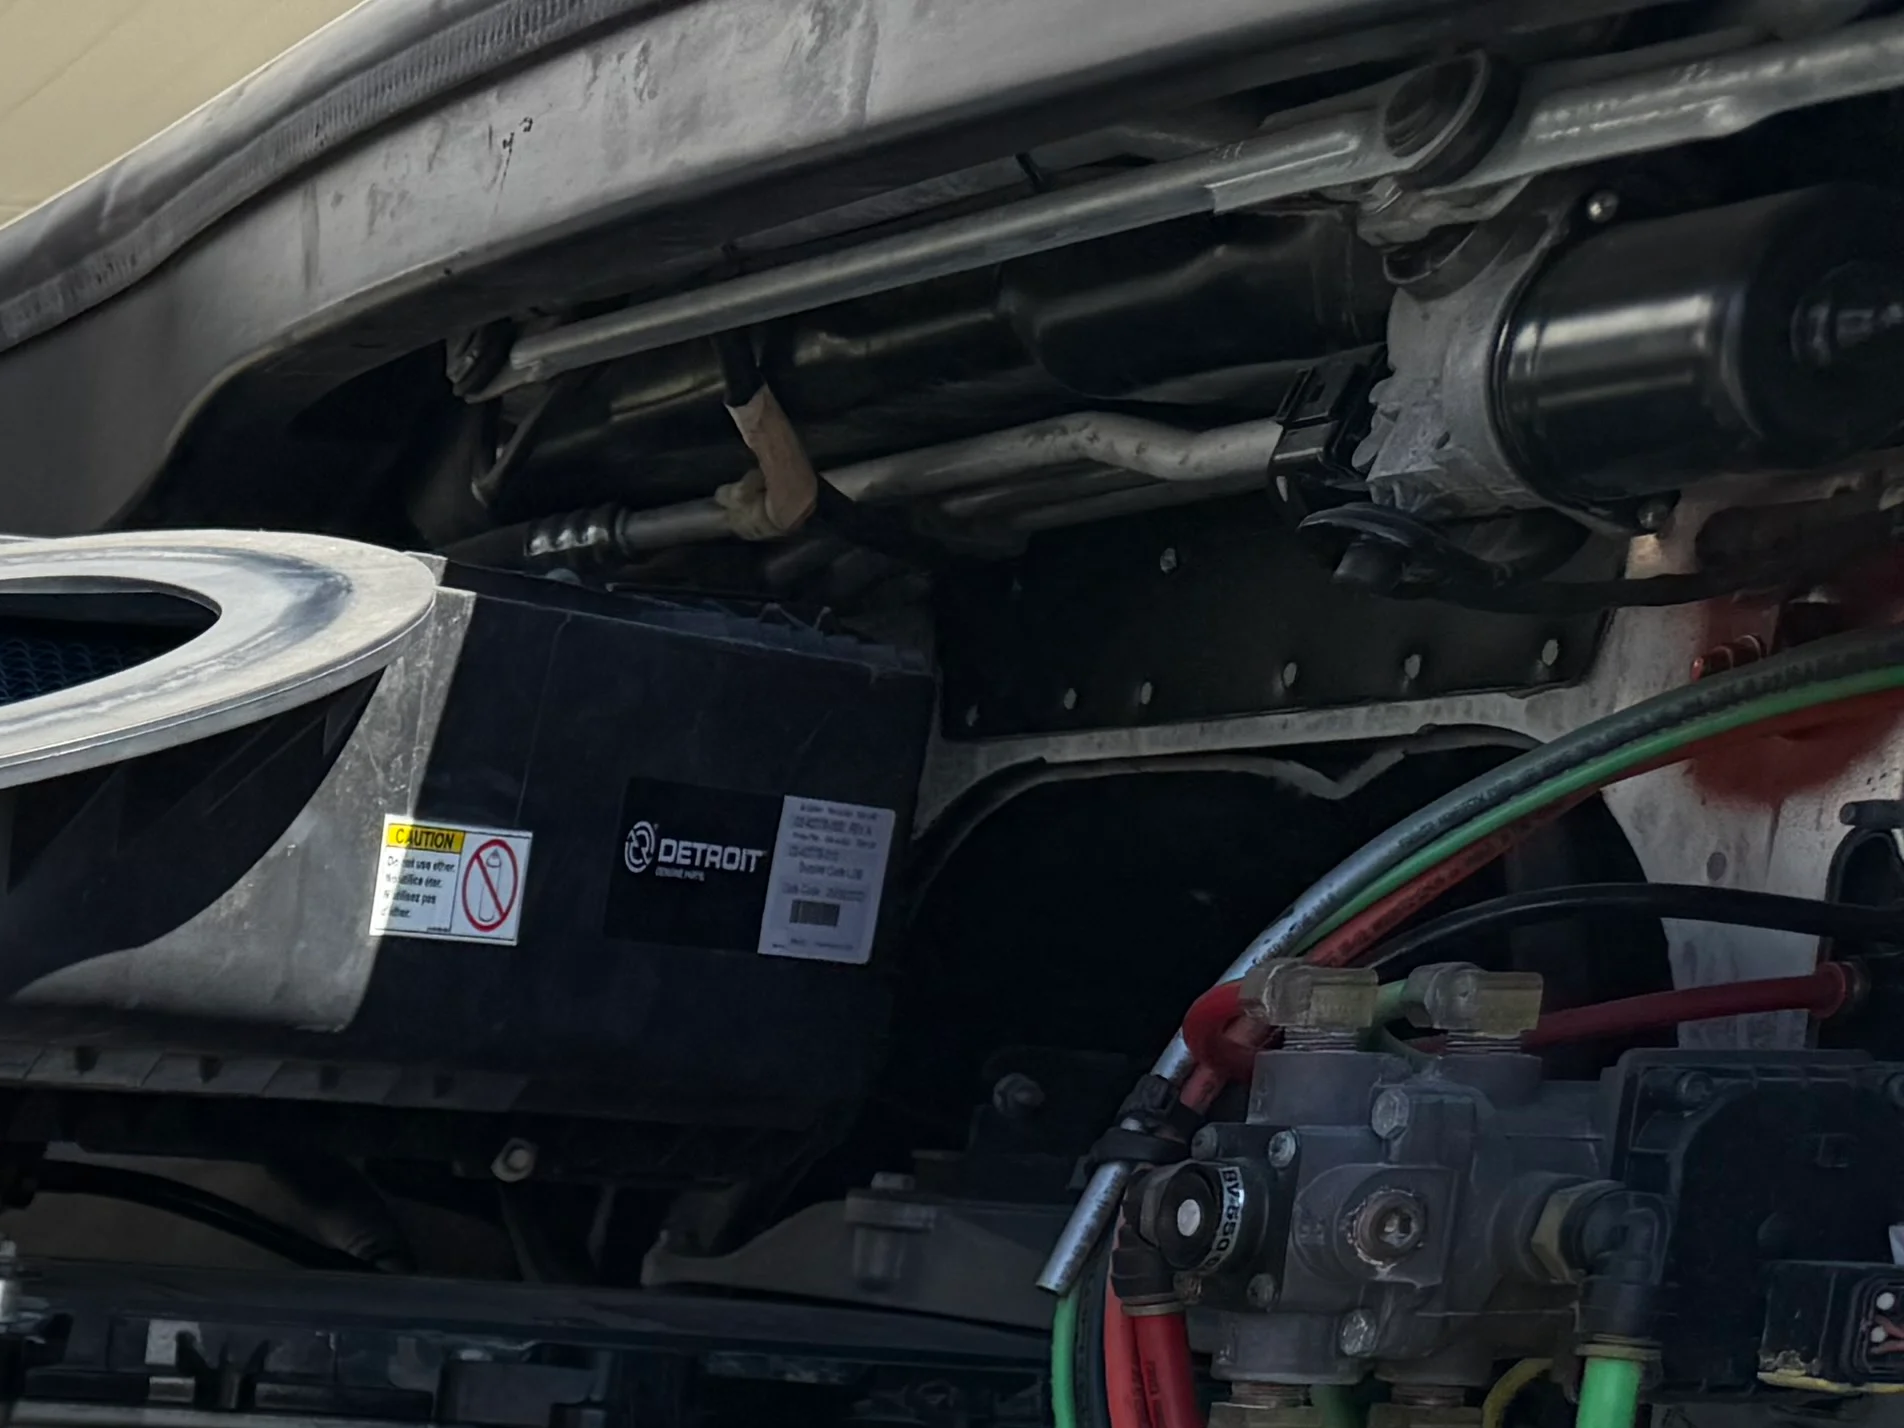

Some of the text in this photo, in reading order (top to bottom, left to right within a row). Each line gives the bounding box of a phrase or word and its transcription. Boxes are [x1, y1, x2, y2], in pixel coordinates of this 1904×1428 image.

[395, 828, 455, 849] CAUTION
[416, 860, 431, 870] use
[658, 838, 765, 873] DETROIT
